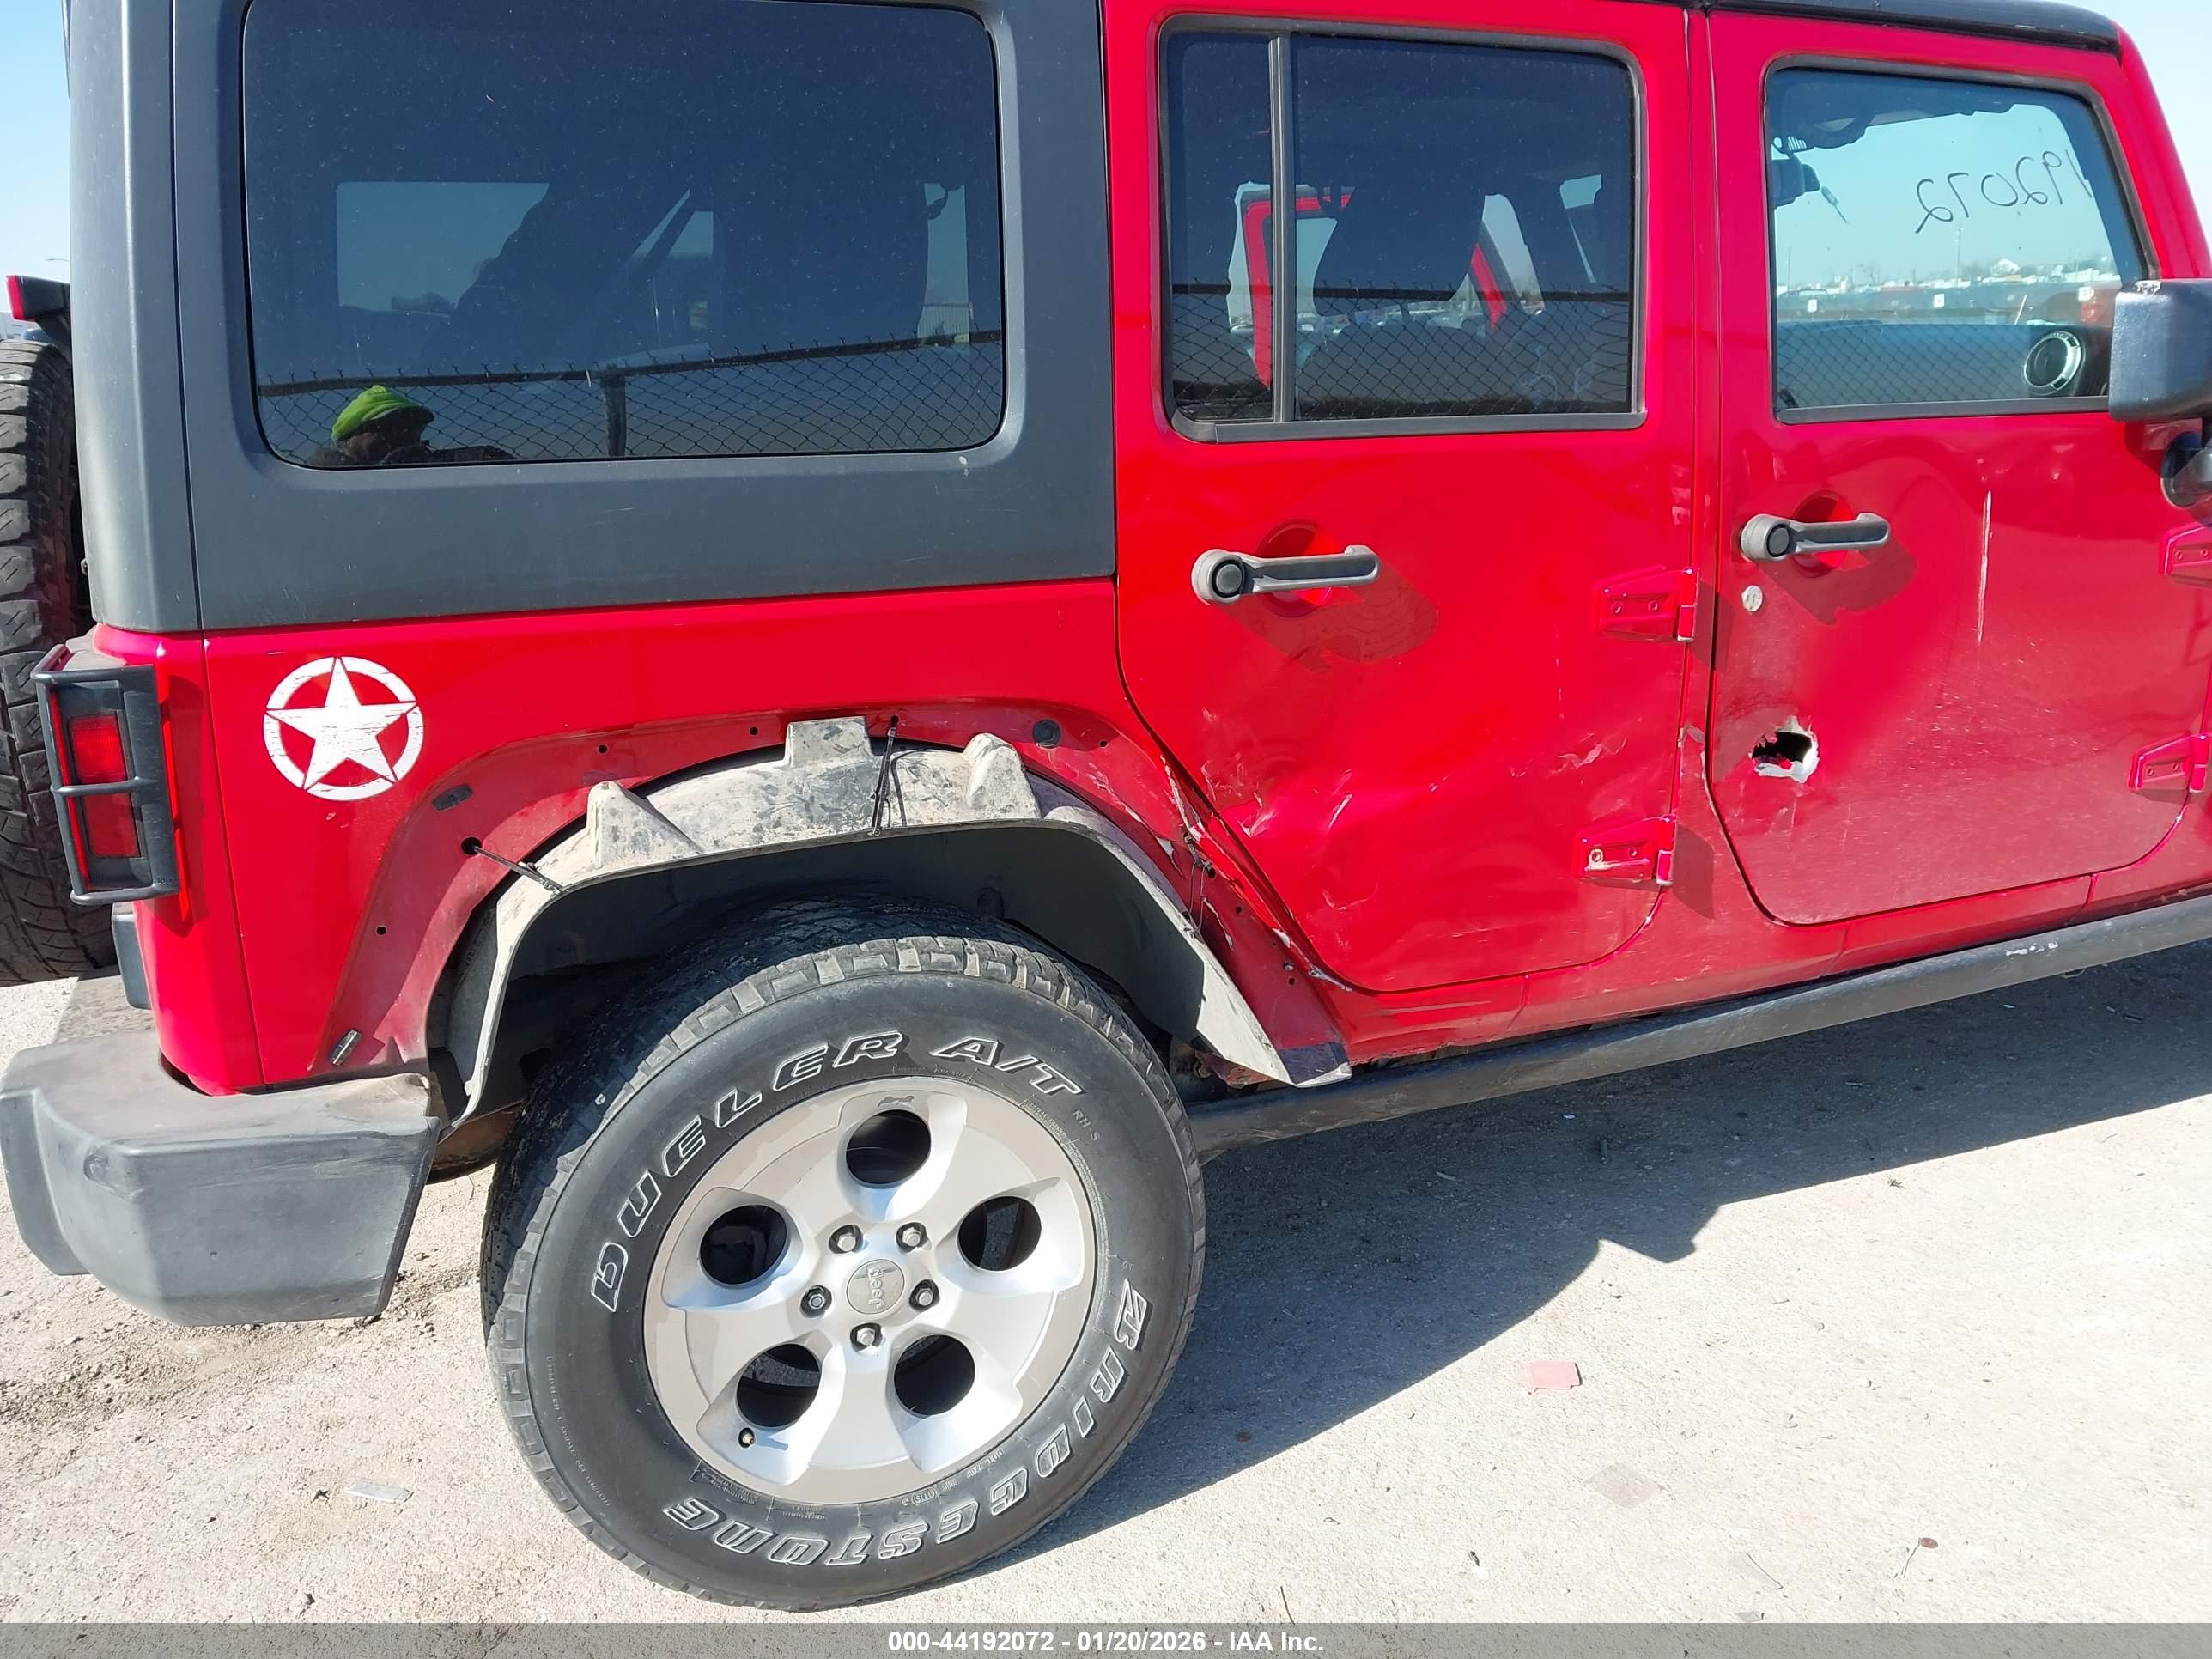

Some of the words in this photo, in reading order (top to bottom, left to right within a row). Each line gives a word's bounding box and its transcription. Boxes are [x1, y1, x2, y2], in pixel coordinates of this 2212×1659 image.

[591, 1030, 903, 1313] DUELER
[928, 1036, 1085, 1095] A/T
[866, 1267, 885, 1310] Jeep
[662, 1278, 1148, 1567] BRIDGESTONE
